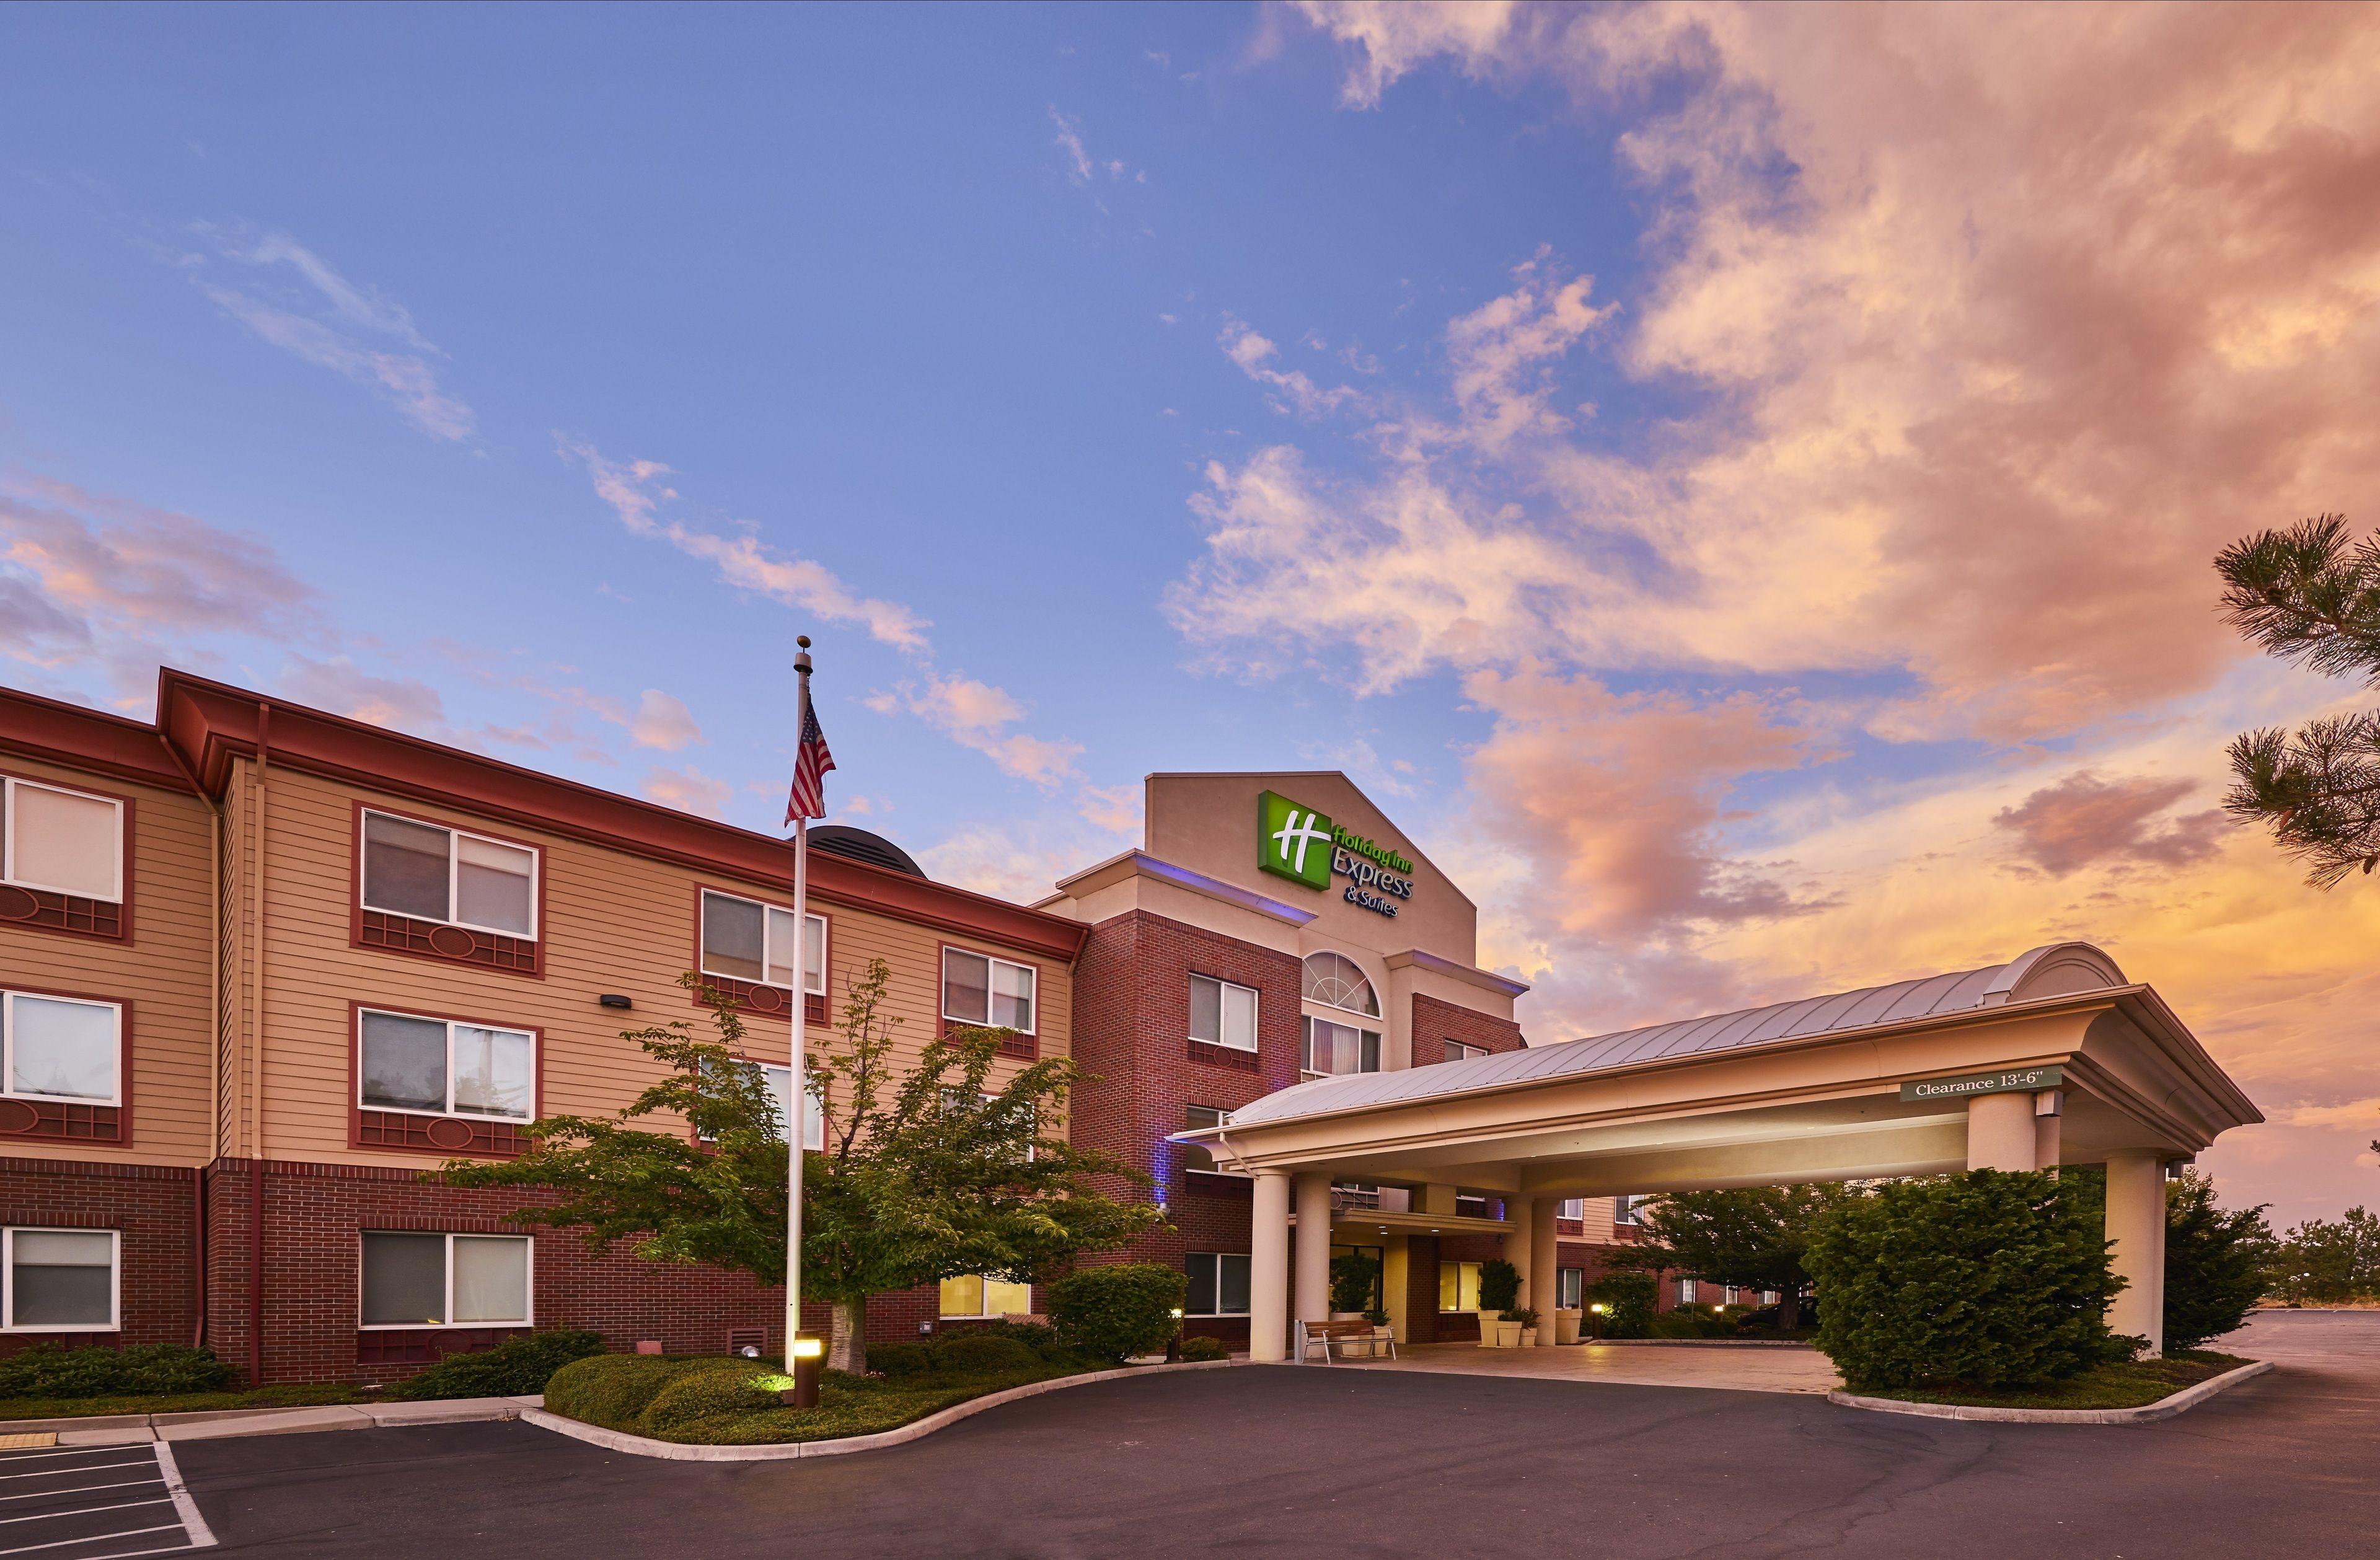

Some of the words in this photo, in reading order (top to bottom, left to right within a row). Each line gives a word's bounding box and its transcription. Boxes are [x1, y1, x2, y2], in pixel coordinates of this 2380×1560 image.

[1333, 826, 1390, 866] Holiday
[1394, 850, 1413, 873] Inn
[1333, 847, 1413, 899] Express
[1347, 886, 1357, 901] &
[1359, 891, 1398, 917] Suites
[1916, 1079, 1994, 1096] Clearance
